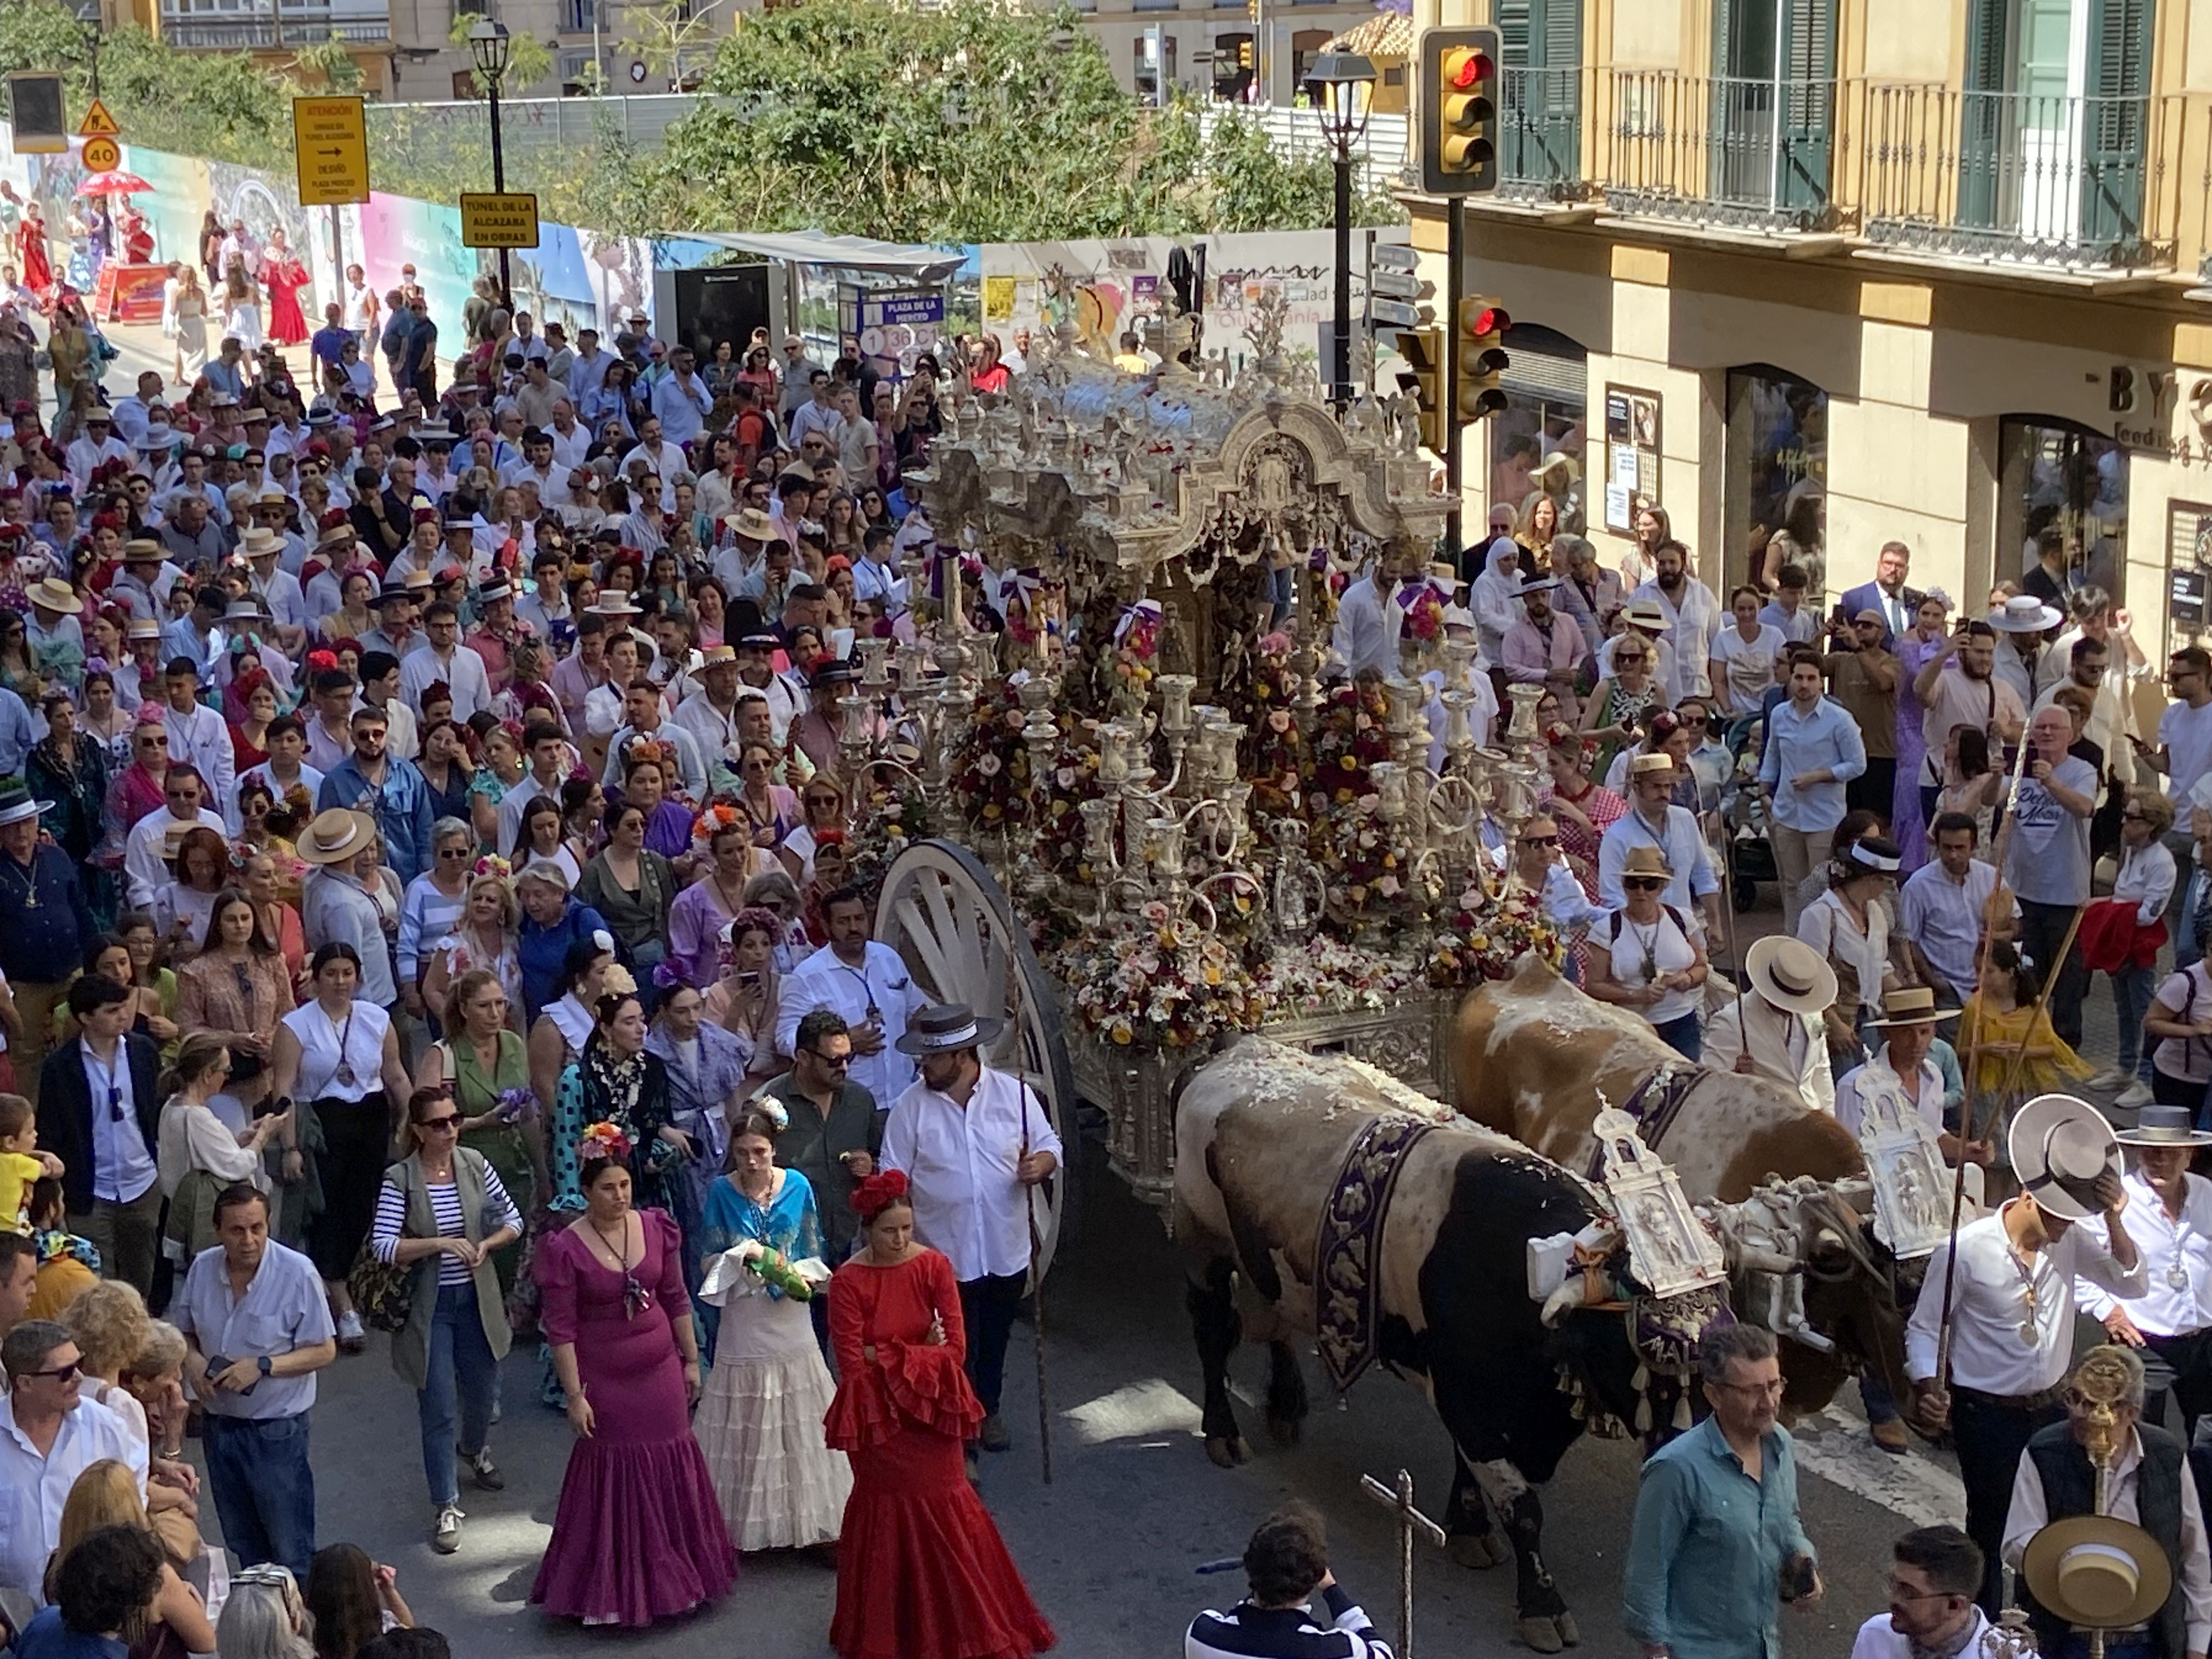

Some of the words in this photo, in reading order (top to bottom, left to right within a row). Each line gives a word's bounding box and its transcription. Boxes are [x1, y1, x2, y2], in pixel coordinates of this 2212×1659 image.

[307, 104, 352, 116] ATENCIÓN
[90, 149, 114, 162] 40
[466, 201, 500, 211] TÚNEL
[503, 202, 516, 211] DE
[518, 202, 531, 211] LA
[473, 217, 526, 226] ALCAZABA
[475, 233, 488, 241] EN
[490, 233, 527, 242] OBRAS
[887, 302, 912, 313] PLAZA
[914, 302, 924, 311] DE
[925, 300, 936, 309] LA
[896, 313, 929, 322] MERCED
[868, 334, 876, 350] 1
[891, 331, 911, 347] 36
[916, 328, 937, 346] C1
